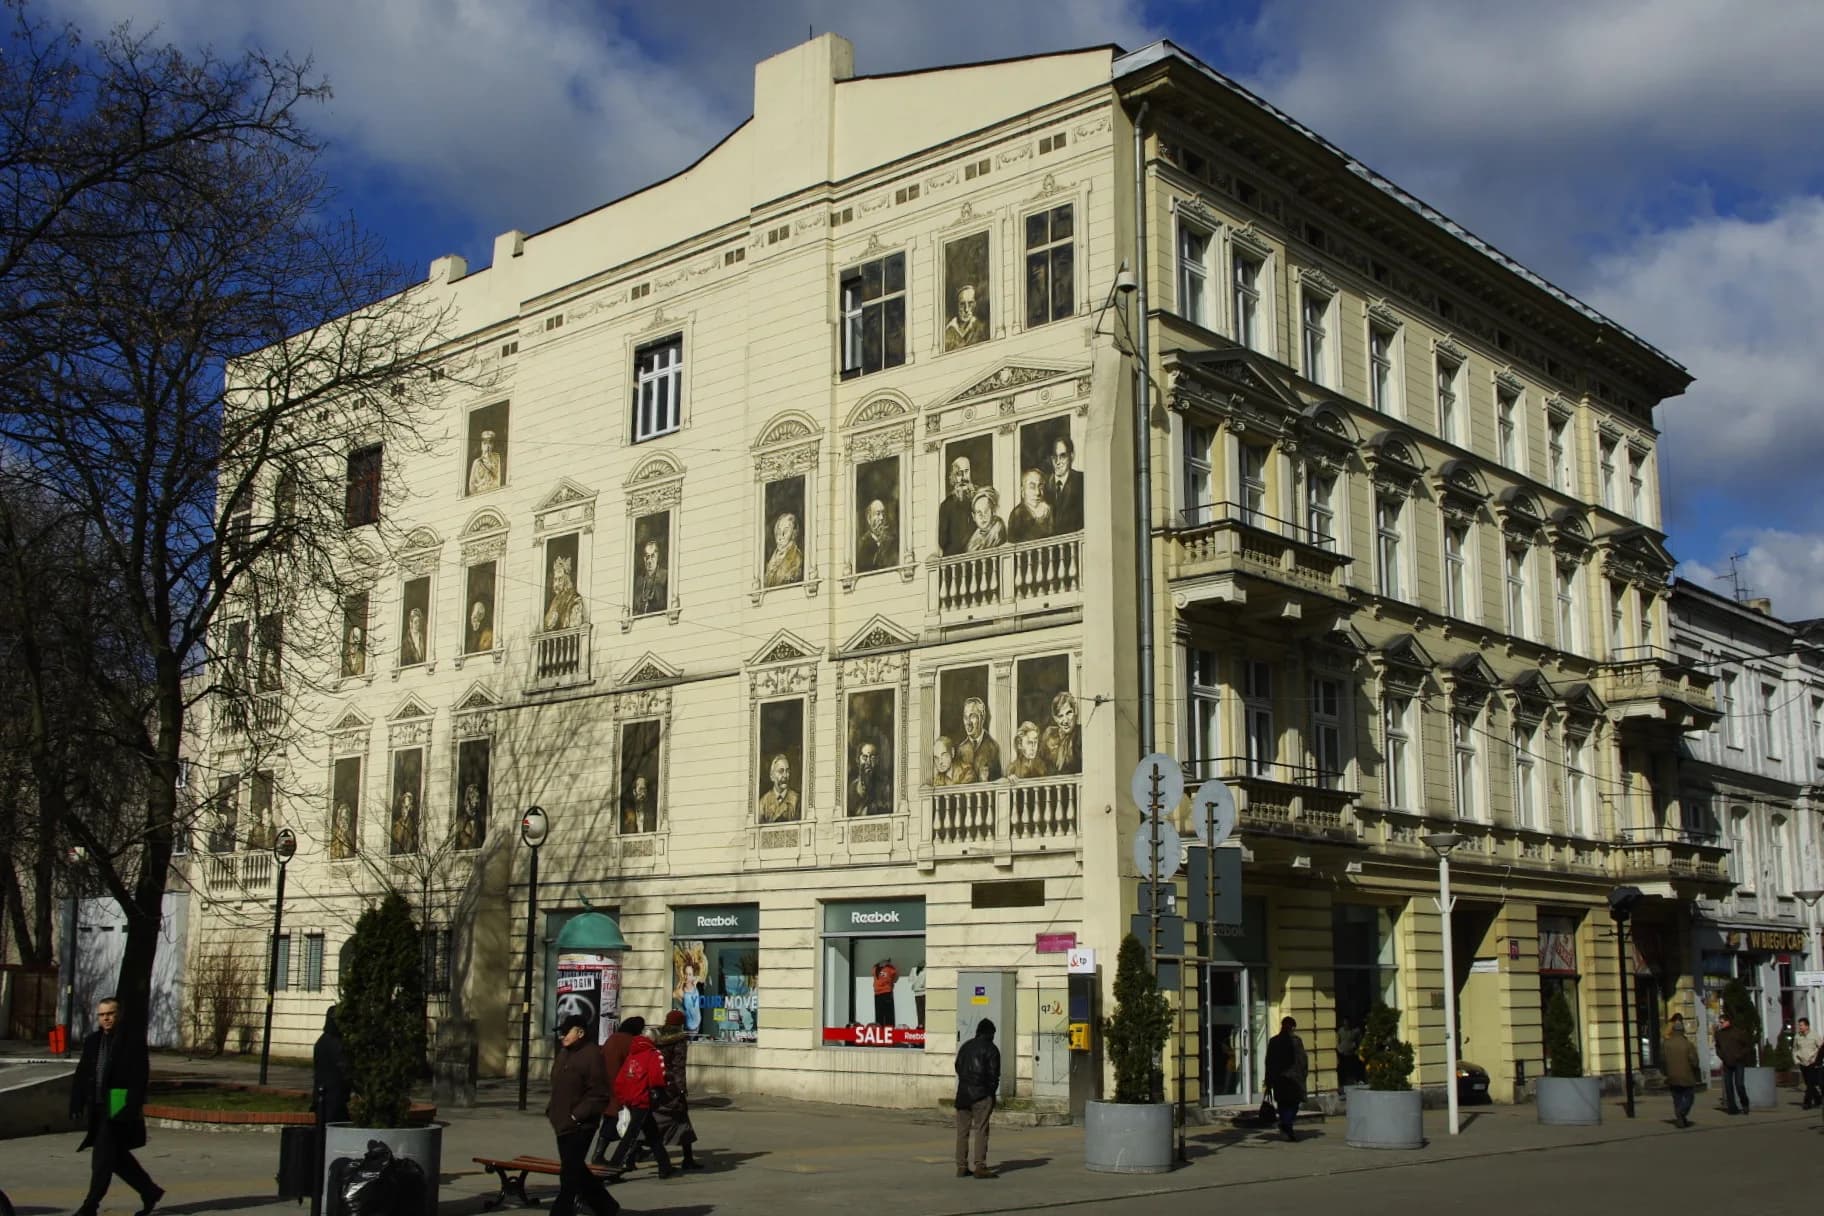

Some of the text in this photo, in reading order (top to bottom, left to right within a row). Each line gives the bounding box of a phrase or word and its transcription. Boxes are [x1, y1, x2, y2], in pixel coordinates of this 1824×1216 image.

[697, 915, 738, 927] Reebok
[851, 911, 900, 923] Reebok
[1080, 957, 1088, 966] tp
[691, 995, 757, 1009] YOUR MOVE
[855, 1026, 893, 1044] SALE
